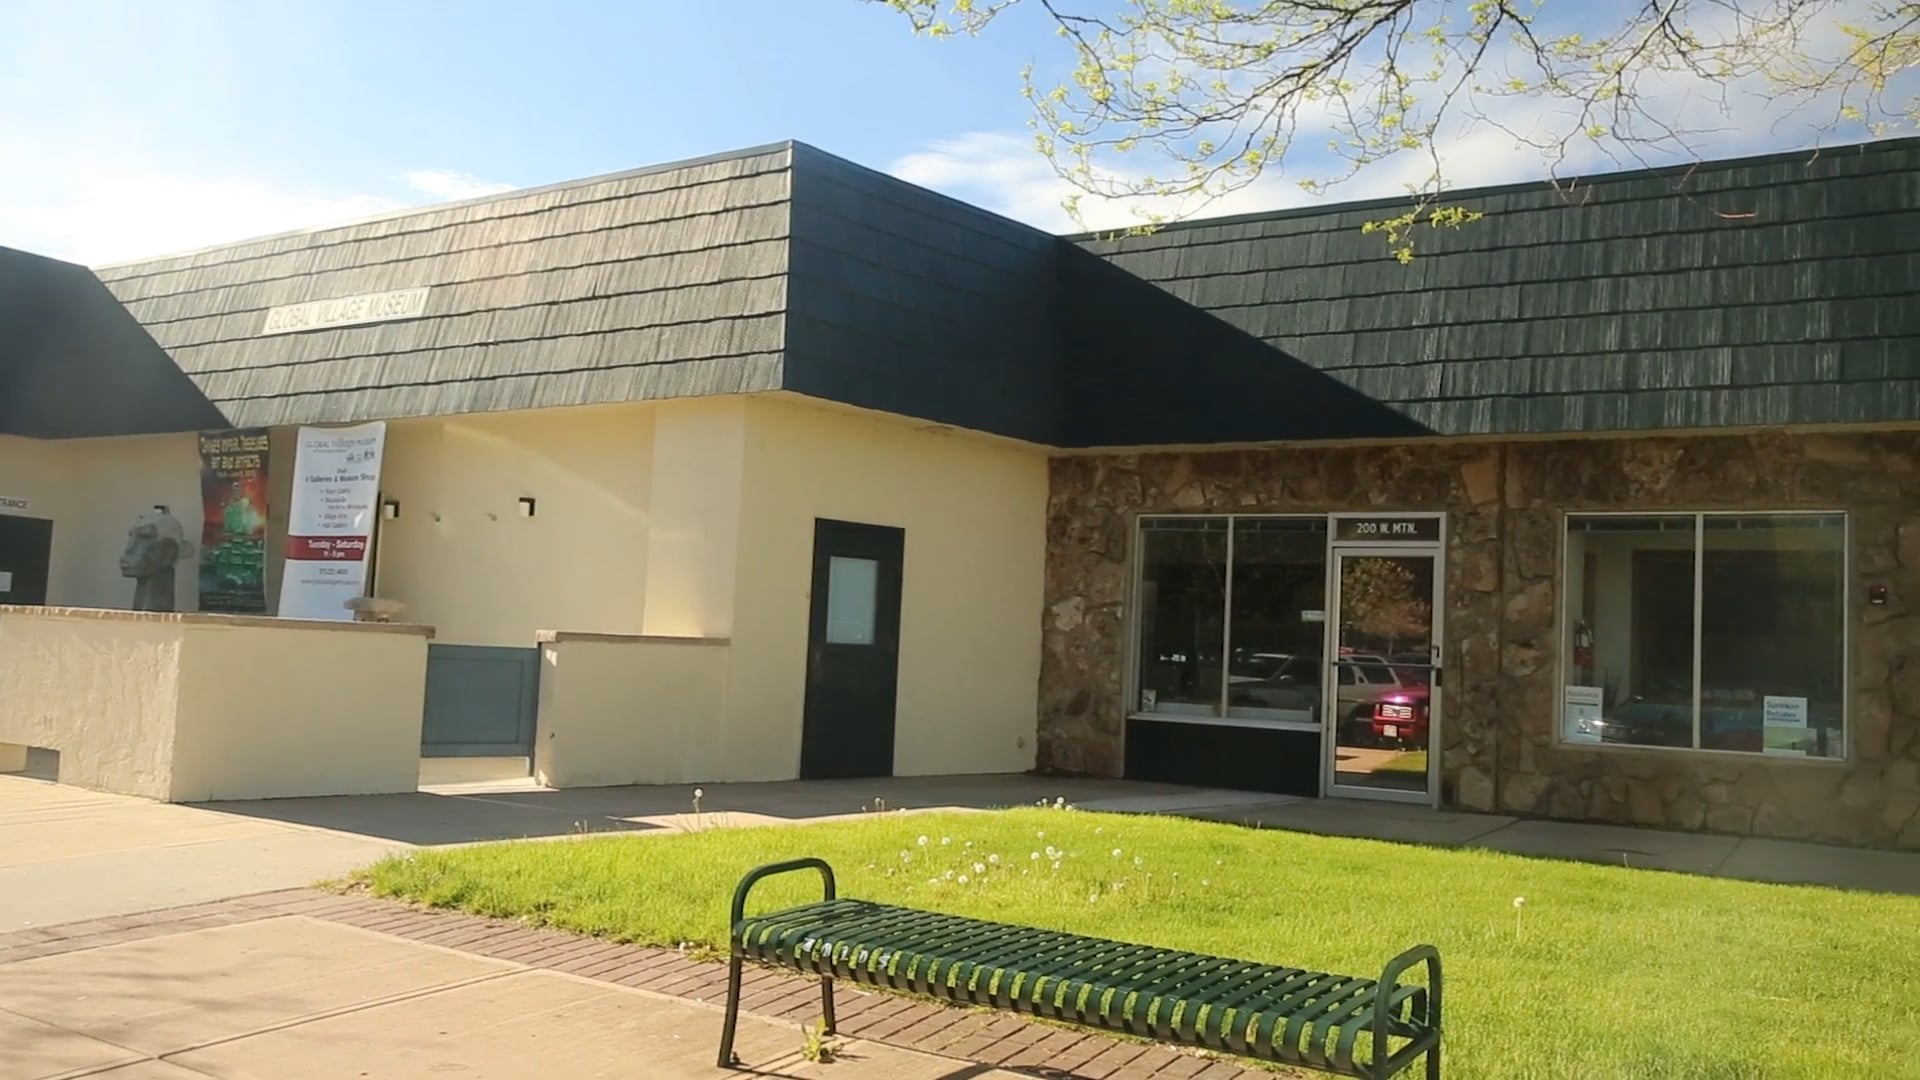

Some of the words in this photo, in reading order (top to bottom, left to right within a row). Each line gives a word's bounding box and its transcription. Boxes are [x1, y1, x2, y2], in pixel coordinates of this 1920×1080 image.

[316, 299, 365, 323] VILLAGE
[369, 292, 425, 317] MUSEUM
[1356, 522, 1377, 534] 200
[1392, 522, 1418, 534] MTN.
[308, 540, 330, 550] Tuesday
[336, 540, 364, 550] Saturday
